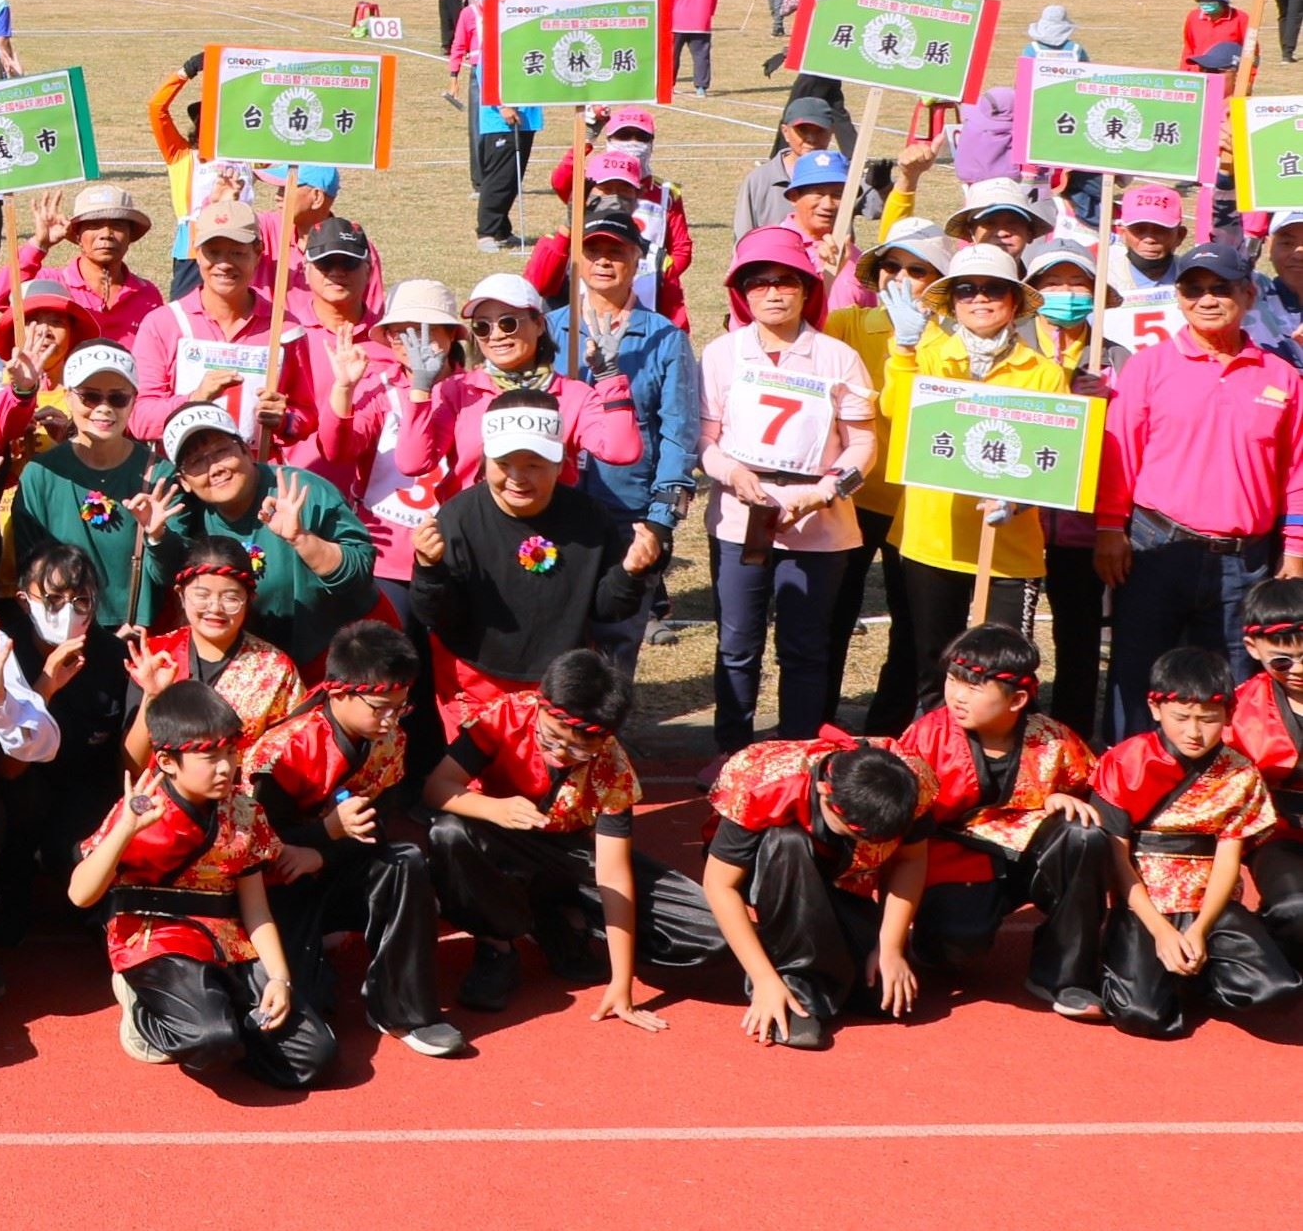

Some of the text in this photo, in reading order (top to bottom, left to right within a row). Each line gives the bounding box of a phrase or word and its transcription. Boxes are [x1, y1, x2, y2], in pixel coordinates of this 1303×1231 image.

[506, 5, 549, 14] CROQUET
[374, 20, 399, 37] 08
[830, 24, 951, 66] 屏東縣
[227, 57, 271, 66] CROQUET
[523, 48, 637, 75] 雲林縣
[1039, 66, 1086, 76] CROQUET
[244, 103, 357, 134] 台南市
[1056, 112, 1180, 146] 台東縣
[1279, 152, 1303, 177] 宜
[1133, 311, 1171, 352] 5
[67, 350, 134, 372] SPORT
[919, 382, 967, 395] CROQUET
[165, 410, 230, 450] SPORT
[487, 415, 561, 436] SPORT
[758, 394, 803, 446] 7
[931, 431, 1059, 472] 高雄市
[397, 463, 447, 511] 3
